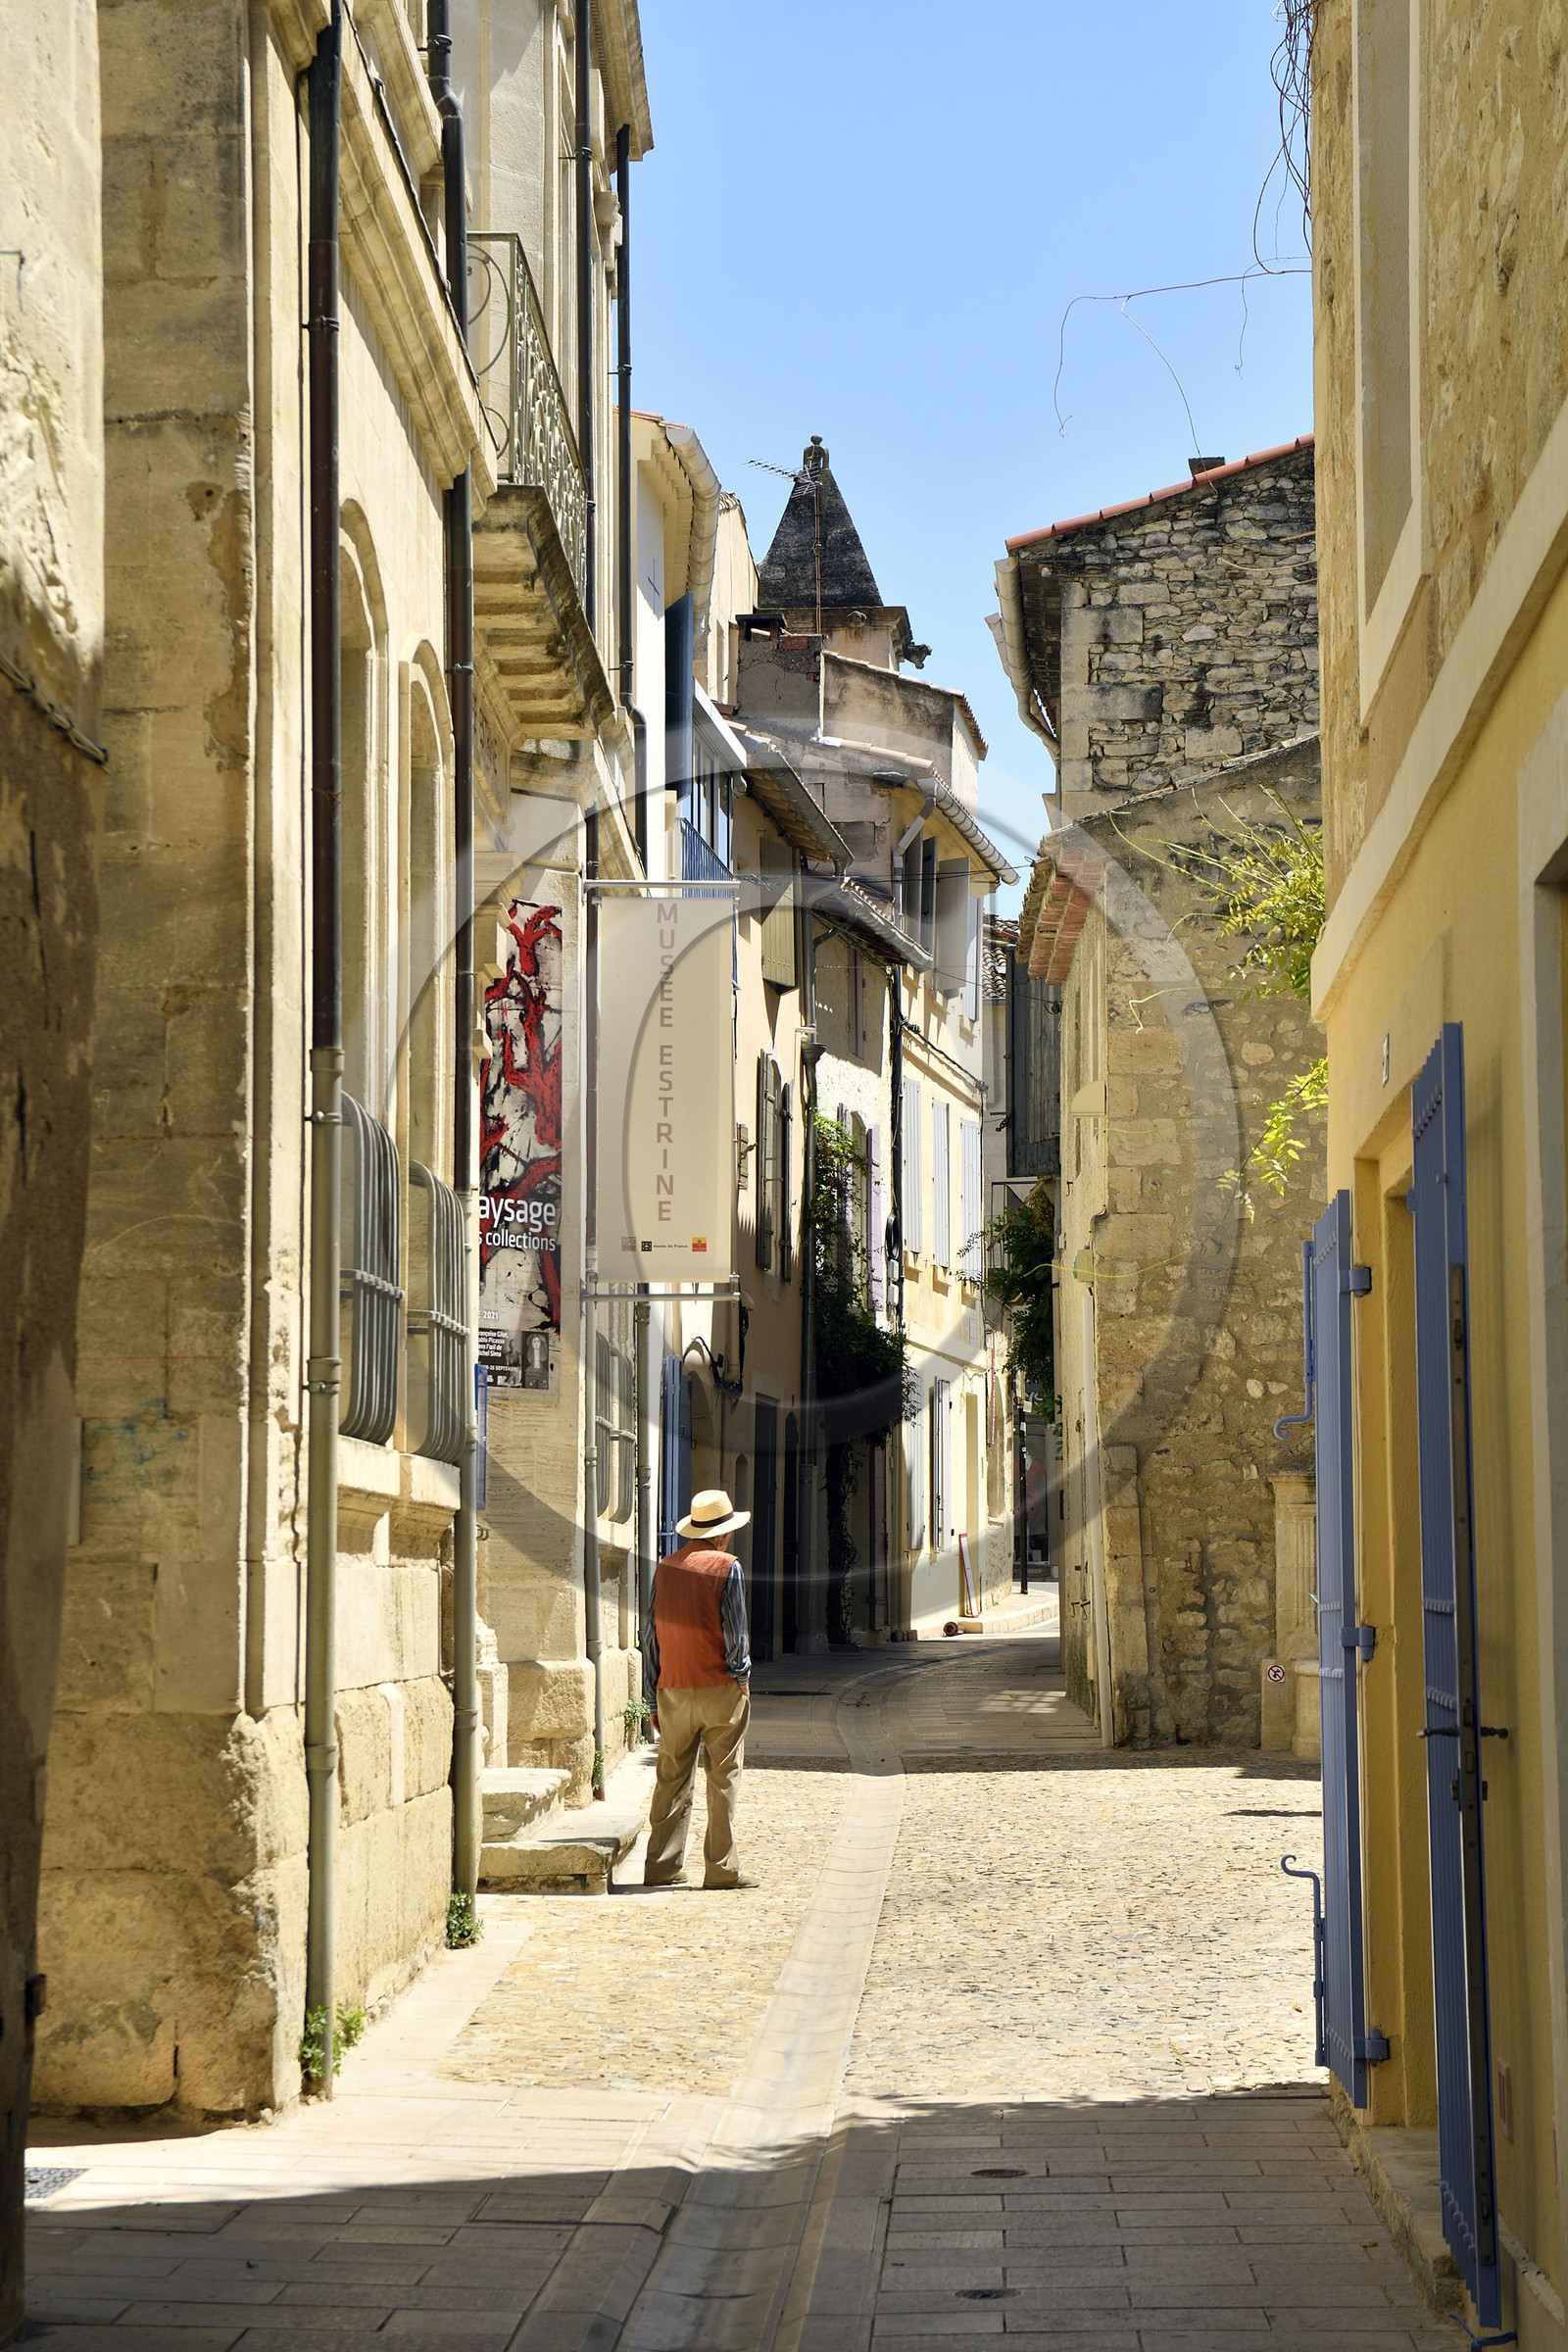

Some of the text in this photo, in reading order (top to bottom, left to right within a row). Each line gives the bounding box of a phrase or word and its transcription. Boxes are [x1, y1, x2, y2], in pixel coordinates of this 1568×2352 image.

[656, 903, 678, 1221] MUSÉE ESTRINE
[485, 1228, 556, 1251] collections
[483, 1310, 499, 1319] 2021
